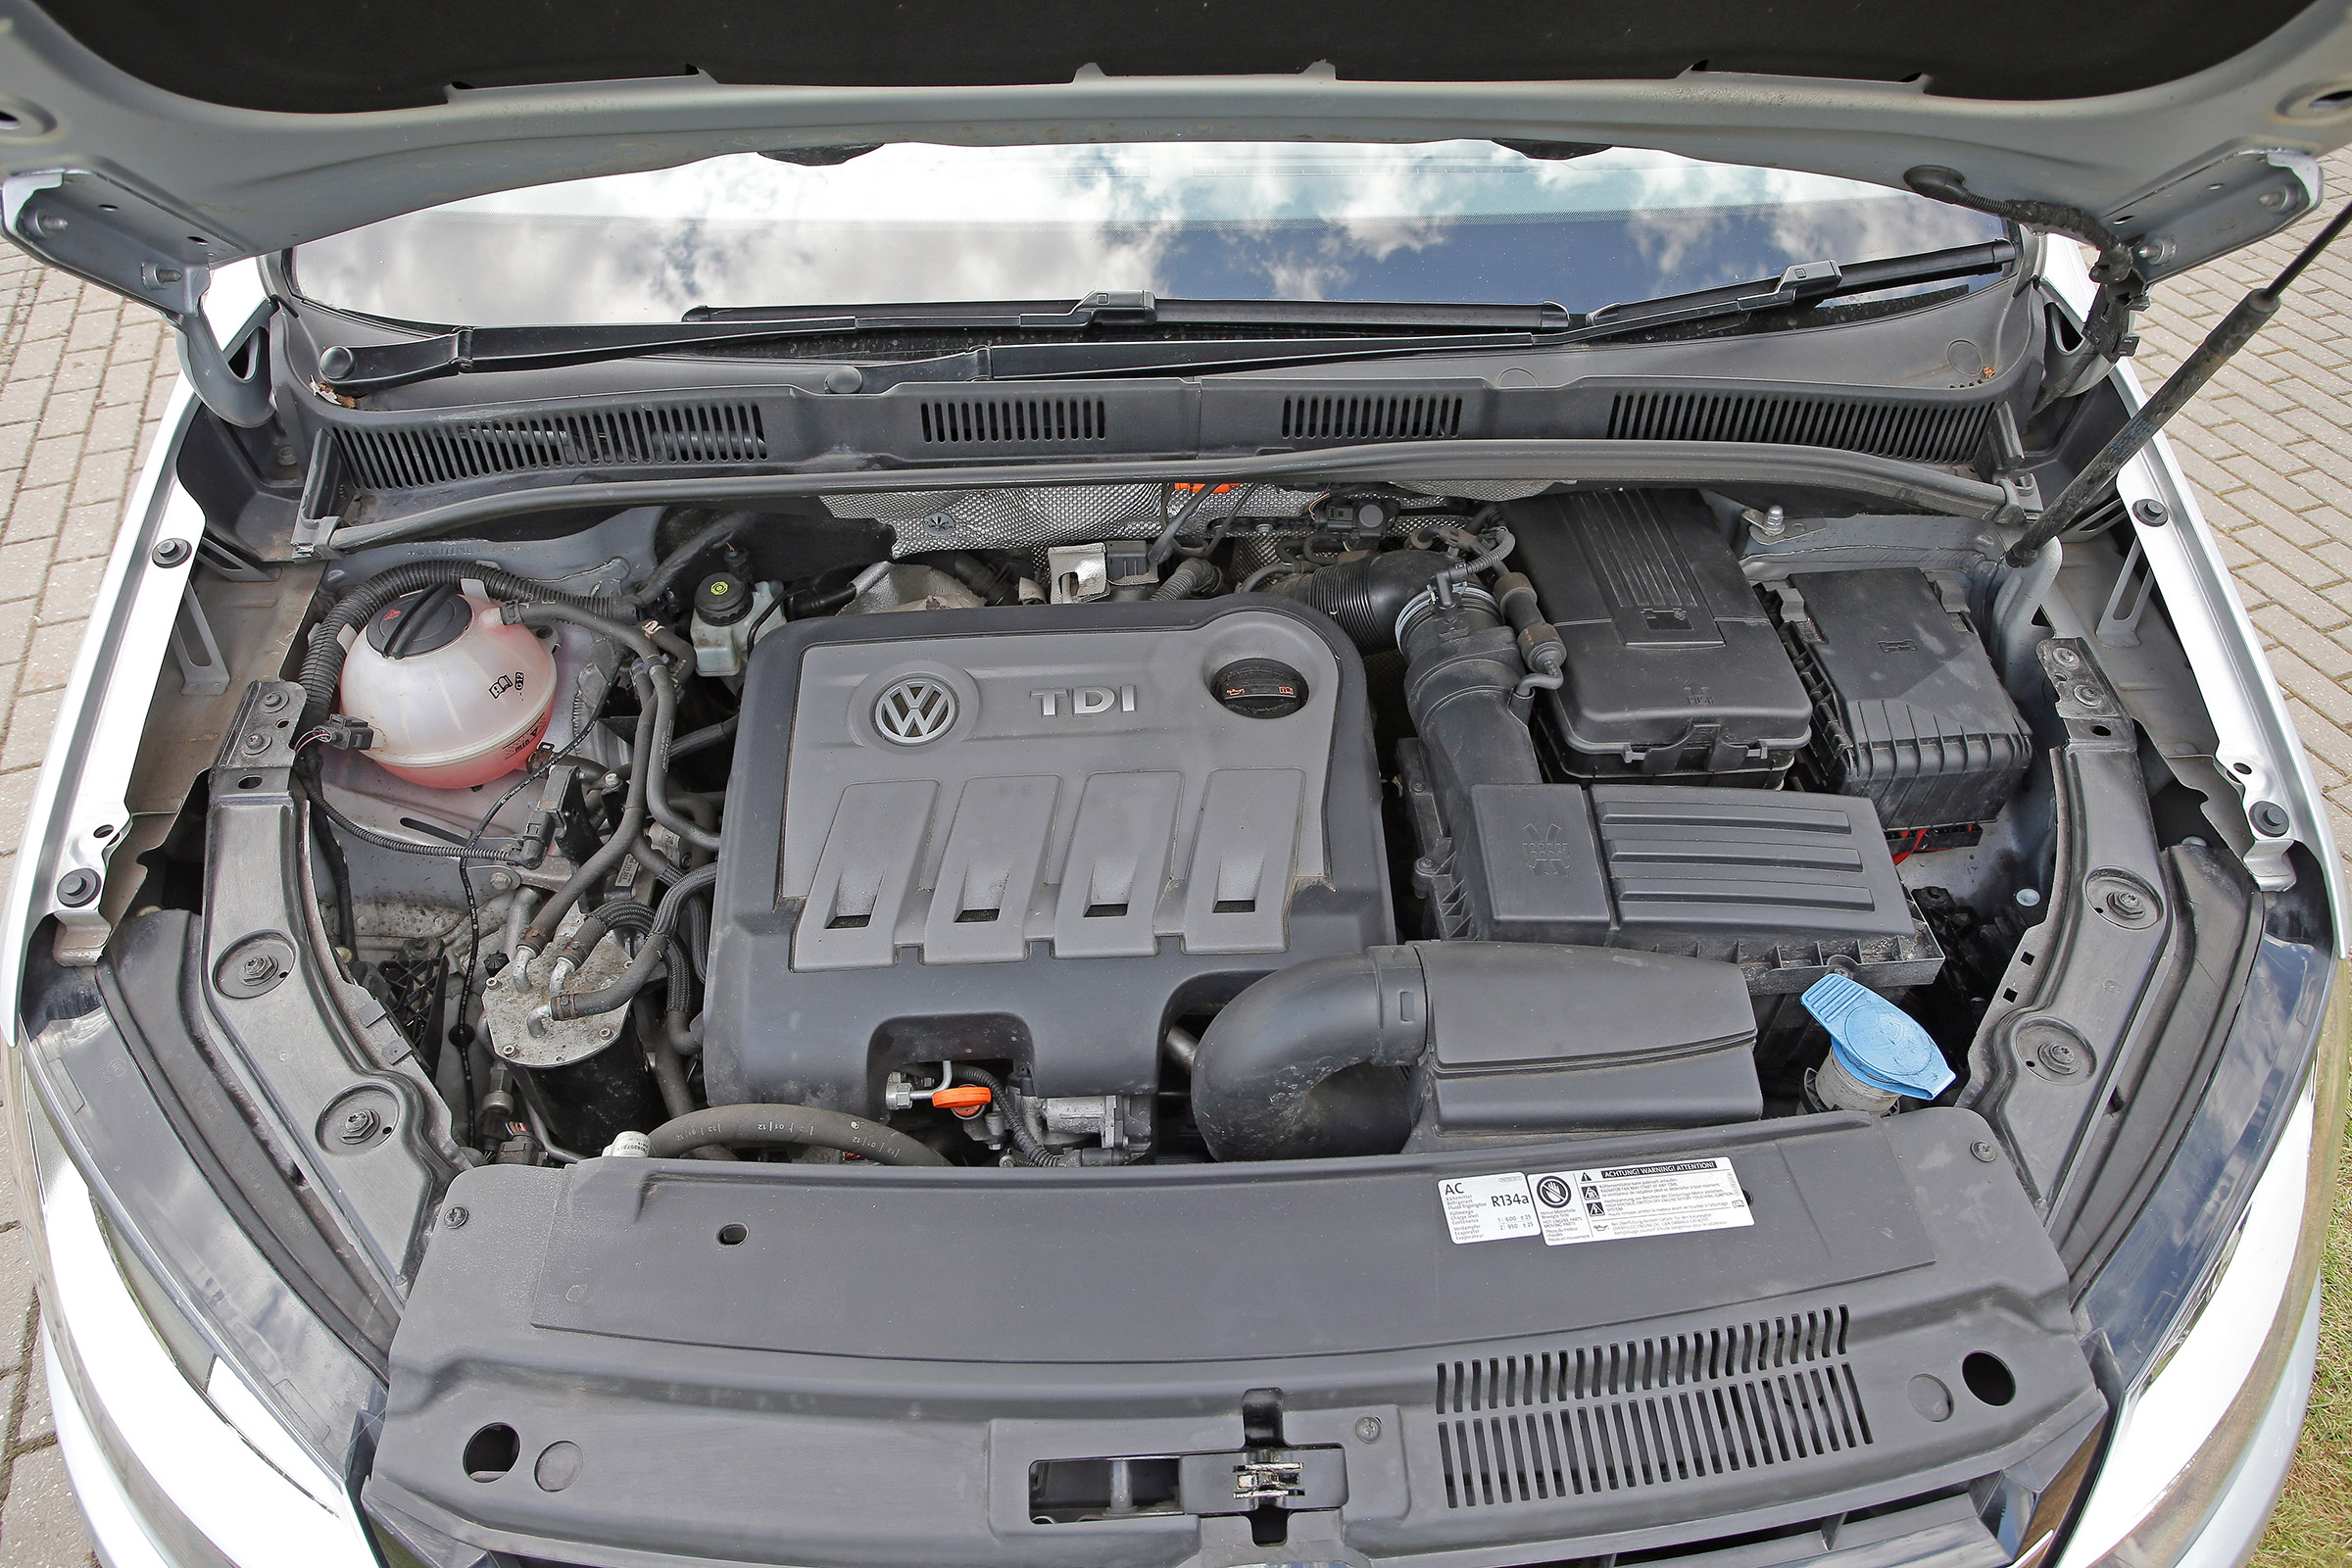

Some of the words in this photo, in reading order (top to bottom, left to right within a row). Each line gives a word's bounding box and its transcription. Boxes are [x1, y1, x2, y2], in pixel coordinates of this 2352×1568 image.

[1029, 685, 1137, 717] TDI
[514, 739, 529, 753] min
[1604, 1169, 1641, 1178] ACHTUNG!
[1641, 1165, 1675, 1175] WARNING!
[1677, 1161, 1715, 1171] ATTENTION!
[1446, 1182, 1464, 1195] AC
[1491, 1194, 1529, 1206] R134a
